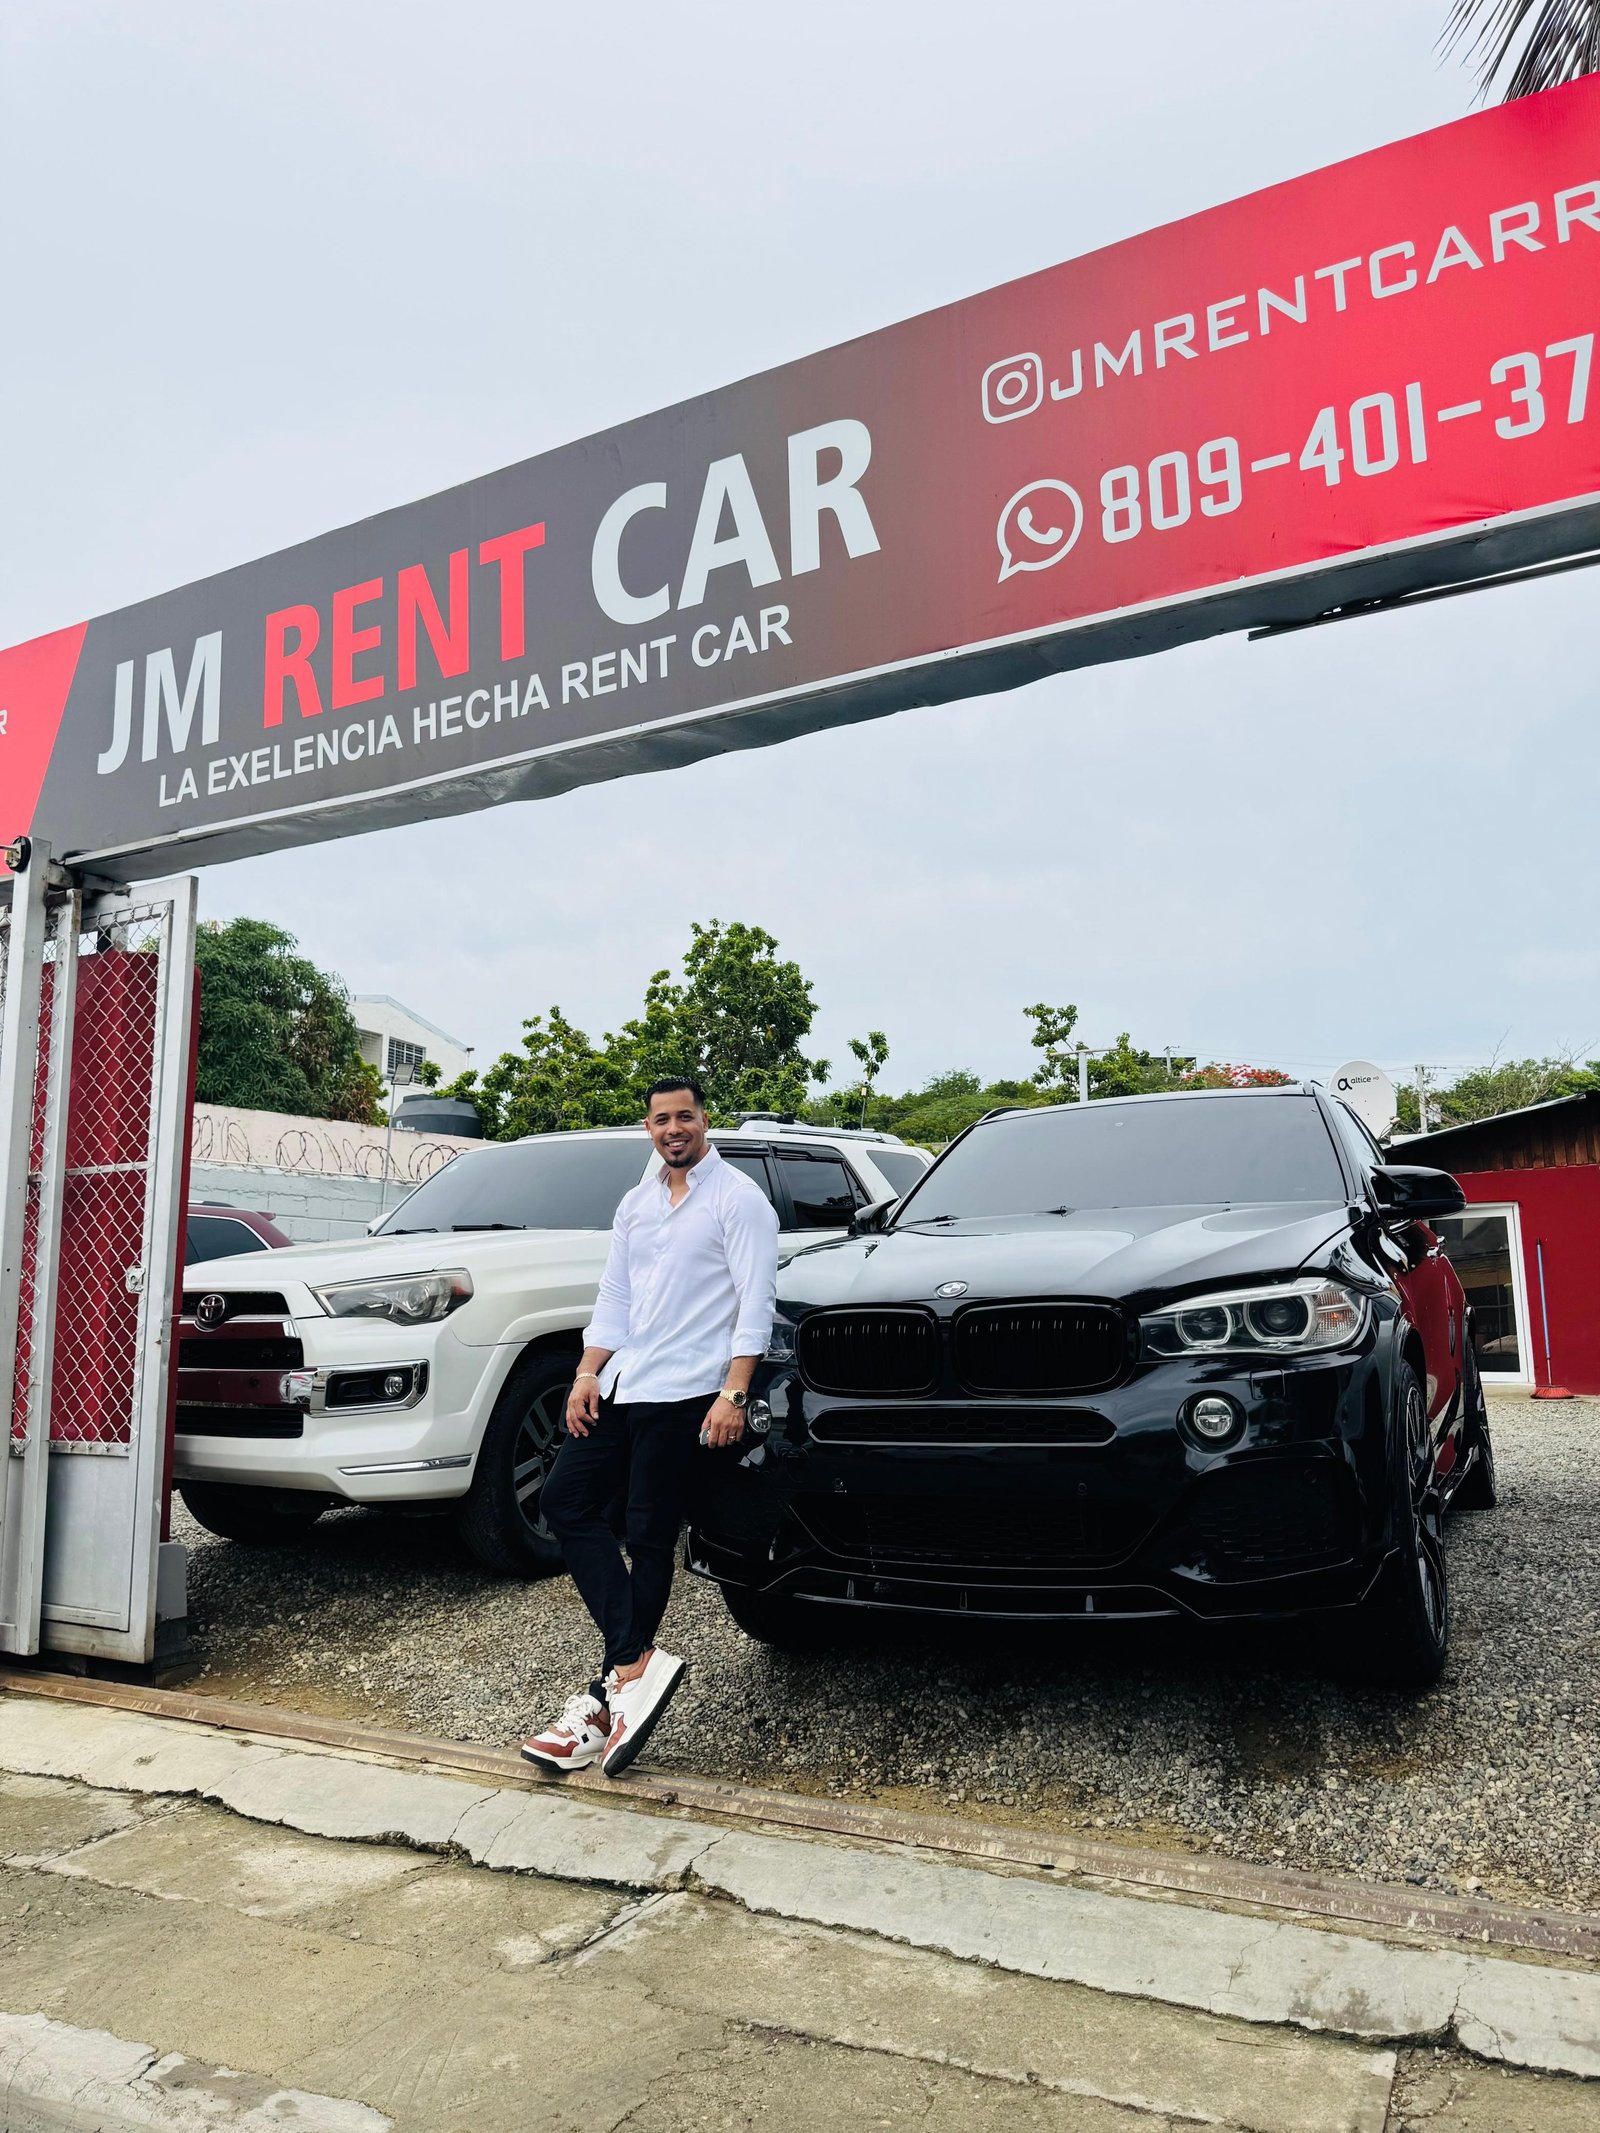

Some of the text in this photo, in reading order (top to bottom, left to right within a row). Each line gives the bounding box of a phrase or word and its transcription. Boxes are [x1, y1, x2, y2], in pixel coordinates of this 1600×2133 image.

[97, 419, 881, 775] JM RENT CAR
[159, 604, 793, 808] LA EXELENCIA HECHA RENT CAR
